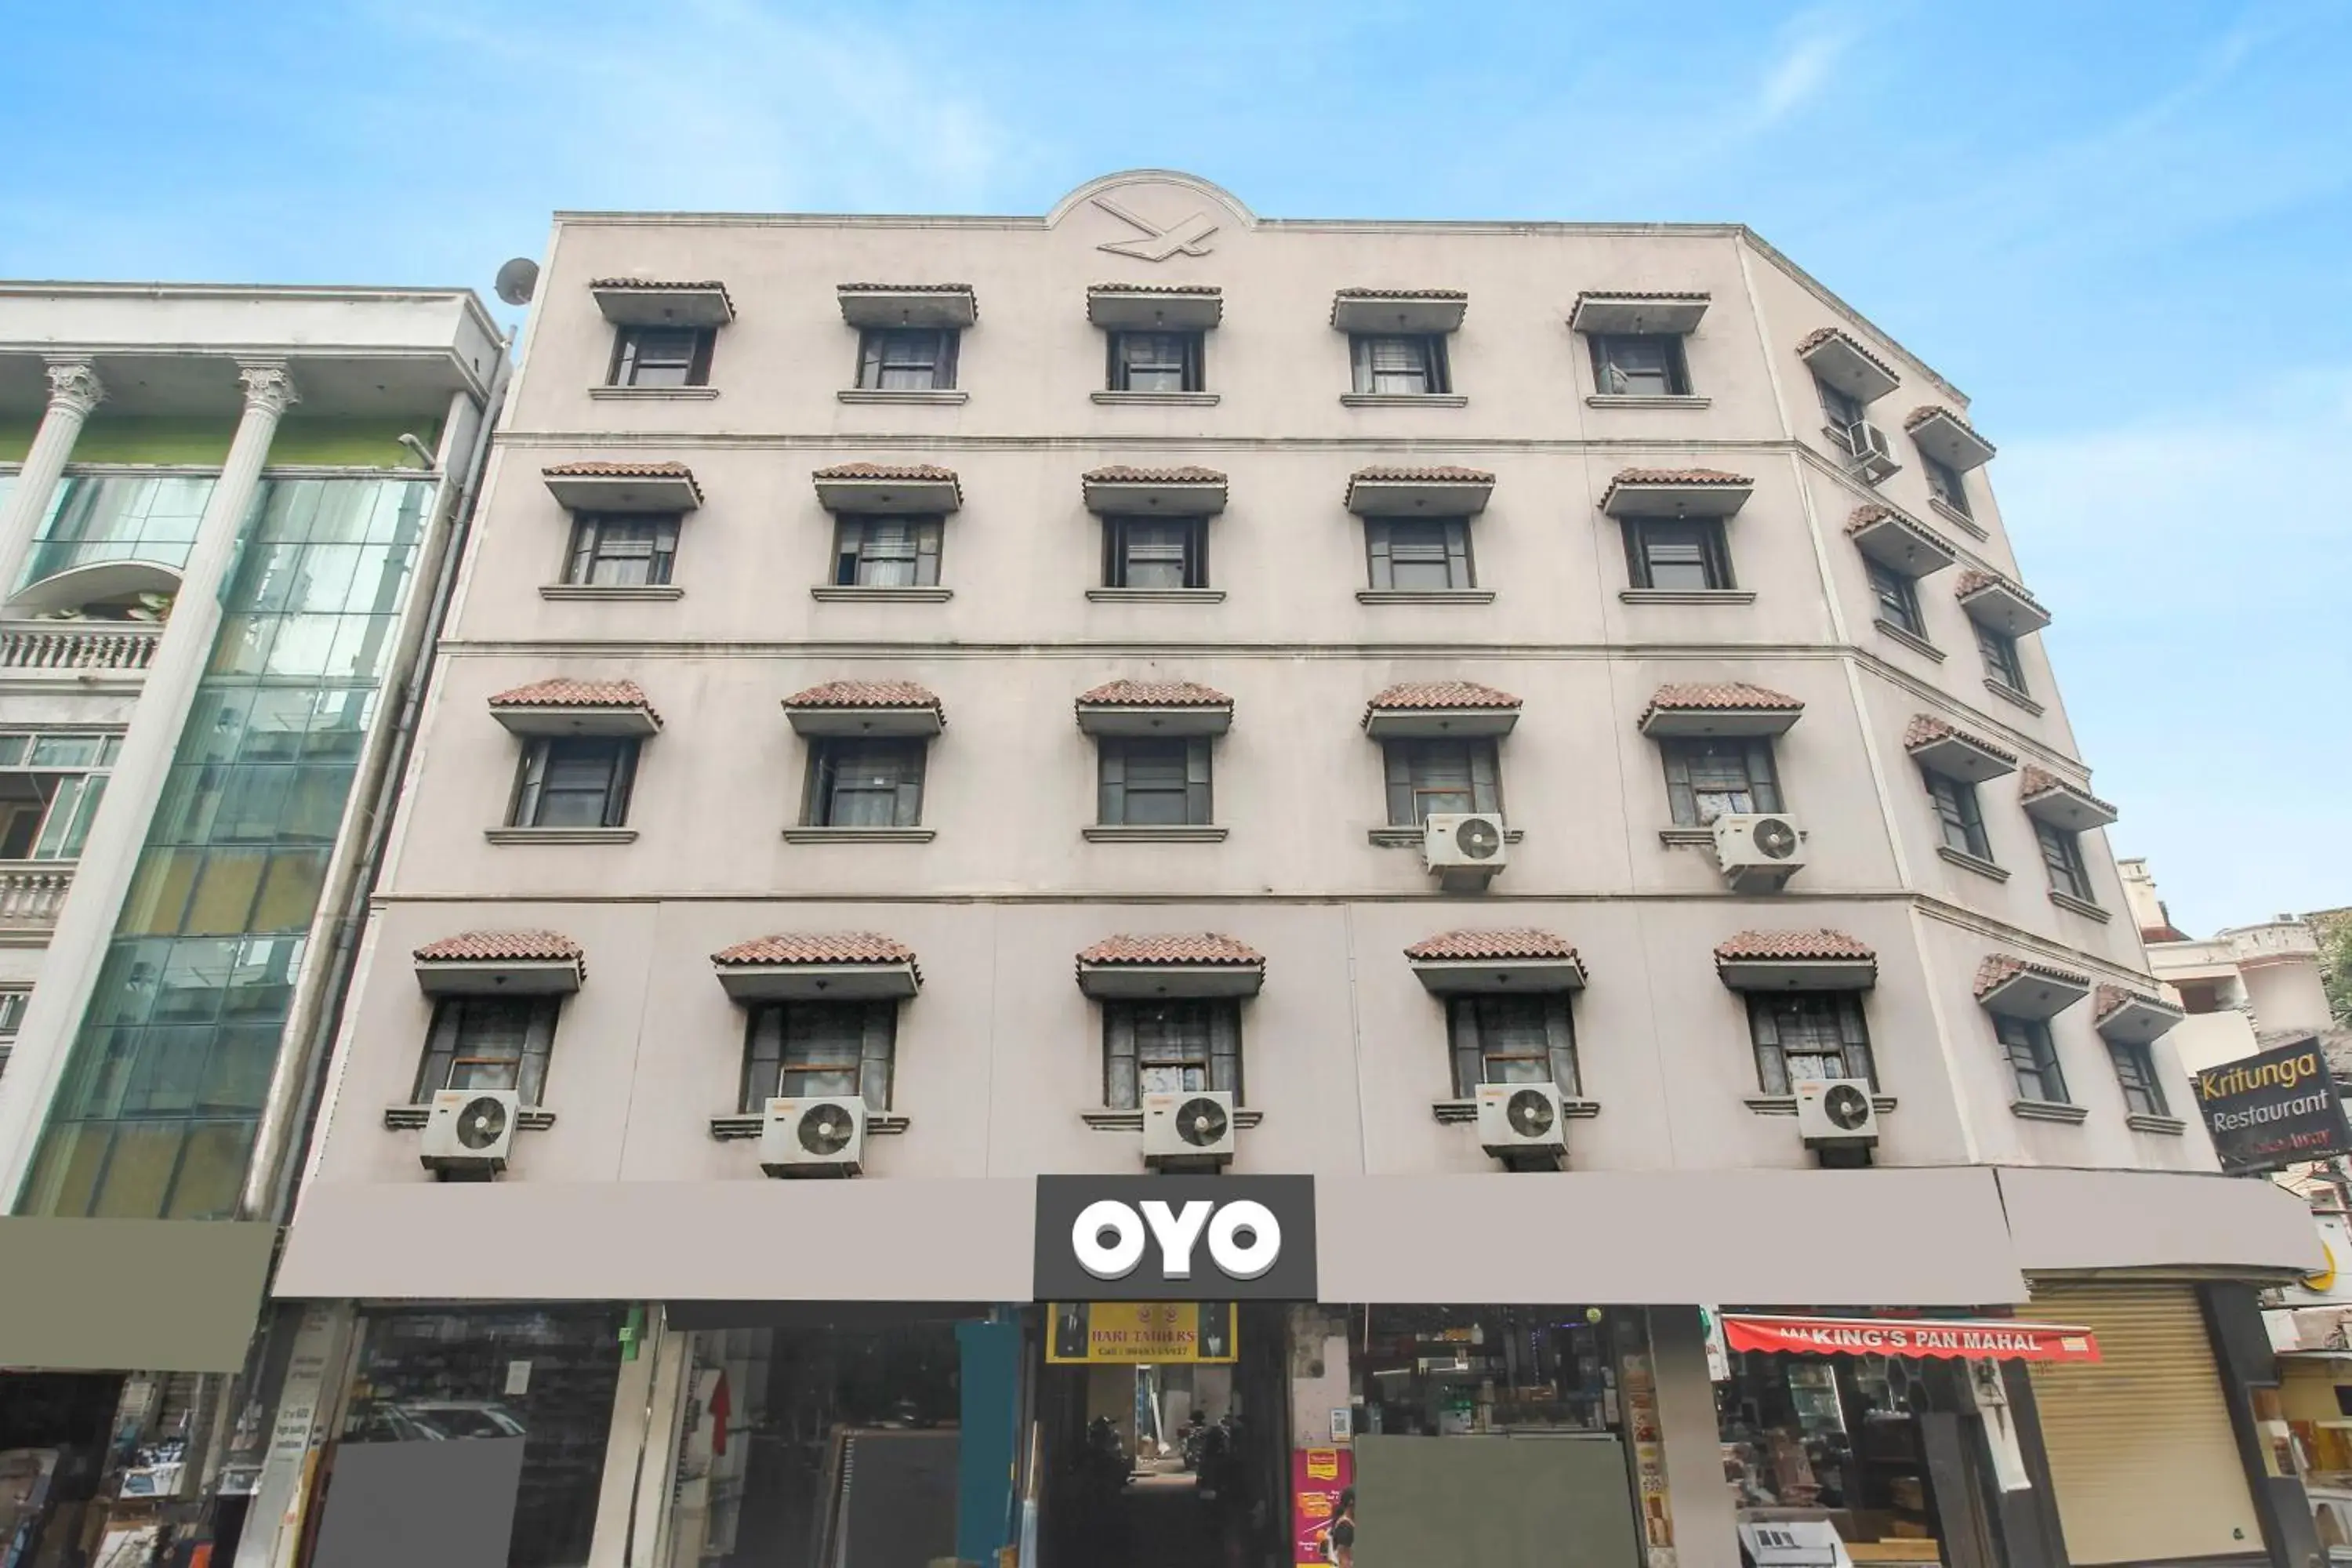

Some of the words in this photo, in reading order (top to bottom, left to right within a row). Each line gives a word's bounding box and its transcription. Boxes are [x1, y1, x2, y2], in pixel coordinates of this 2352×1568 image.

[2201, 1053, 2318, 1101] Kritunga
[2213, 1089, 2330, 1134] Restaurant
[1072, 1200, 1281, 1280] OYO
[1812, 1329, 1907, 1347] KING'S
[1915, 1331, 1958, 1348] PAN
[1963, 1332, 2042, 1351] MAHAL
